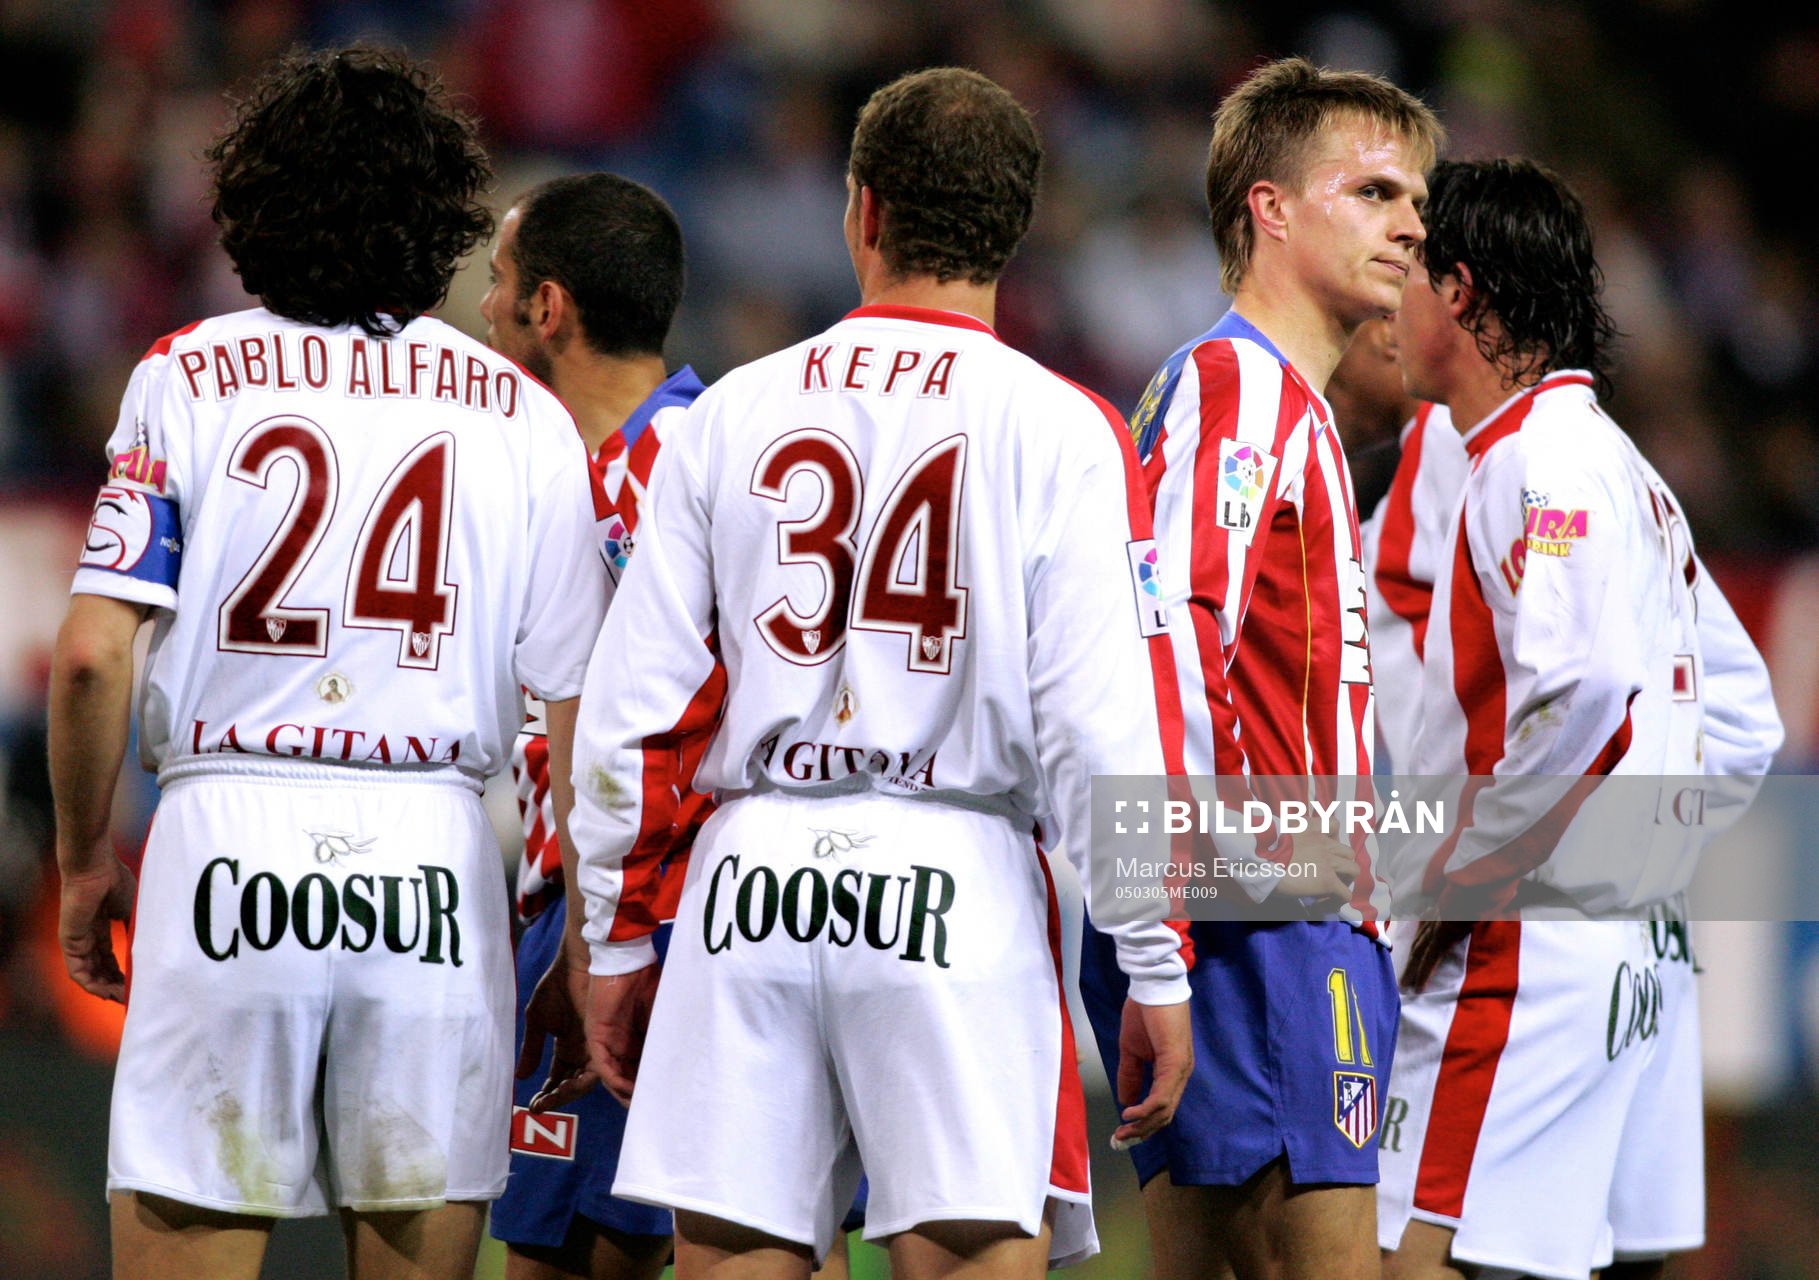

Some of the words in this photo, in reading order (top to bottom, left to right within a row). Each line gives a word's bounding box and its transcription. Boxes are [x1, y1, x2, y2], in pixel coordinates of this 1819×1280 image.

[175, 332, 330, 401] PABLO
[346, 334, 520, 419] ALFARO
[800, 343, 963, 399] KEPA
[218, 414, 458, 671] 24
[750, 428, 968, 675] 34
[193, 719, 250, 754] LA
[265, 723, 460, 764] GITANA
[194, 856, 463, 967] COOSUR
[703, 854, 956, 968] COOSUR
